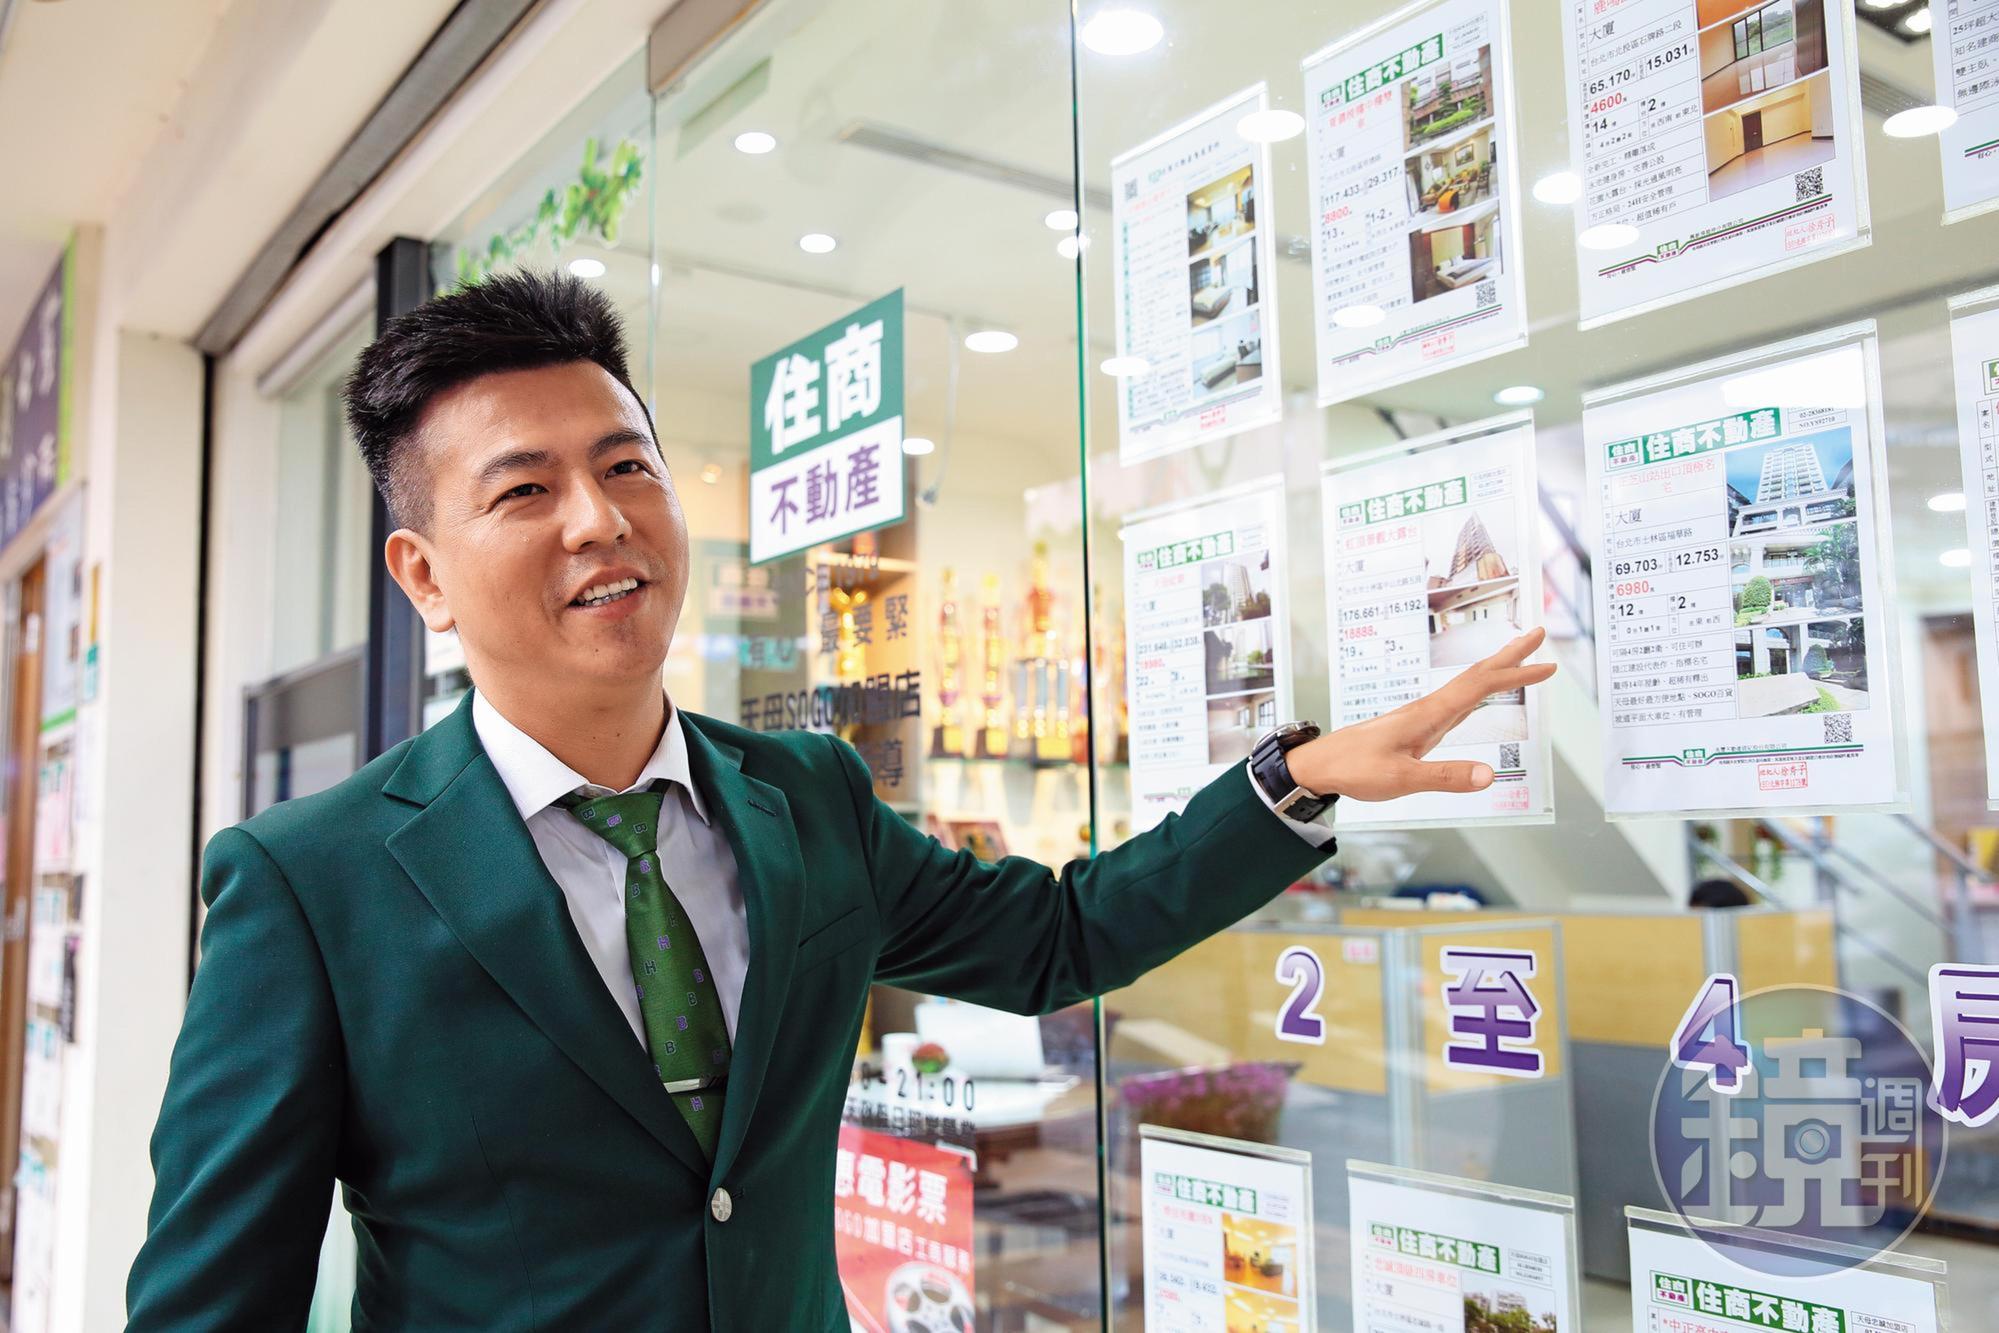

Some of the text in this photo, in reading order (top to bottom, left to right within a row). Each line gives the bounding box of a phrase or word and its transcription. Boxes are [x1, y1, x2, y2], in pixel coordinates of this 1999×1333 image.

[1589, 20, 1615, 44] 大廈
[1646, 44, 1688, 70] 15.031
[1590, 69, 1631, 94] 65.170
[1590, 92, 1622, 113] 4600
[1592, 118, 1608, 133] 14
[764, 318, 884, 455] 住商
[1645, 410, 1777, 462] 住商不動產
[770, 444, 881, 536] 不動產
[1614, 508, 1642, 525] 大廈
[1675, 548, 1719, 566] 12.753
[1615, 558, 1658, 576] 69.703
[1616, 580, 1649, 597] 6980
[1389, 600, 1422, 614] 16.192
[1618, 603, 1634, 617] 12
[1677, 596, 1686, 610] 2
[1399, 1228, 1498, 1273] 住商不動產
[1658, 1276, 1686, 1293] 住商
[1695, 1281, 1840, 1333] 住商不動產
